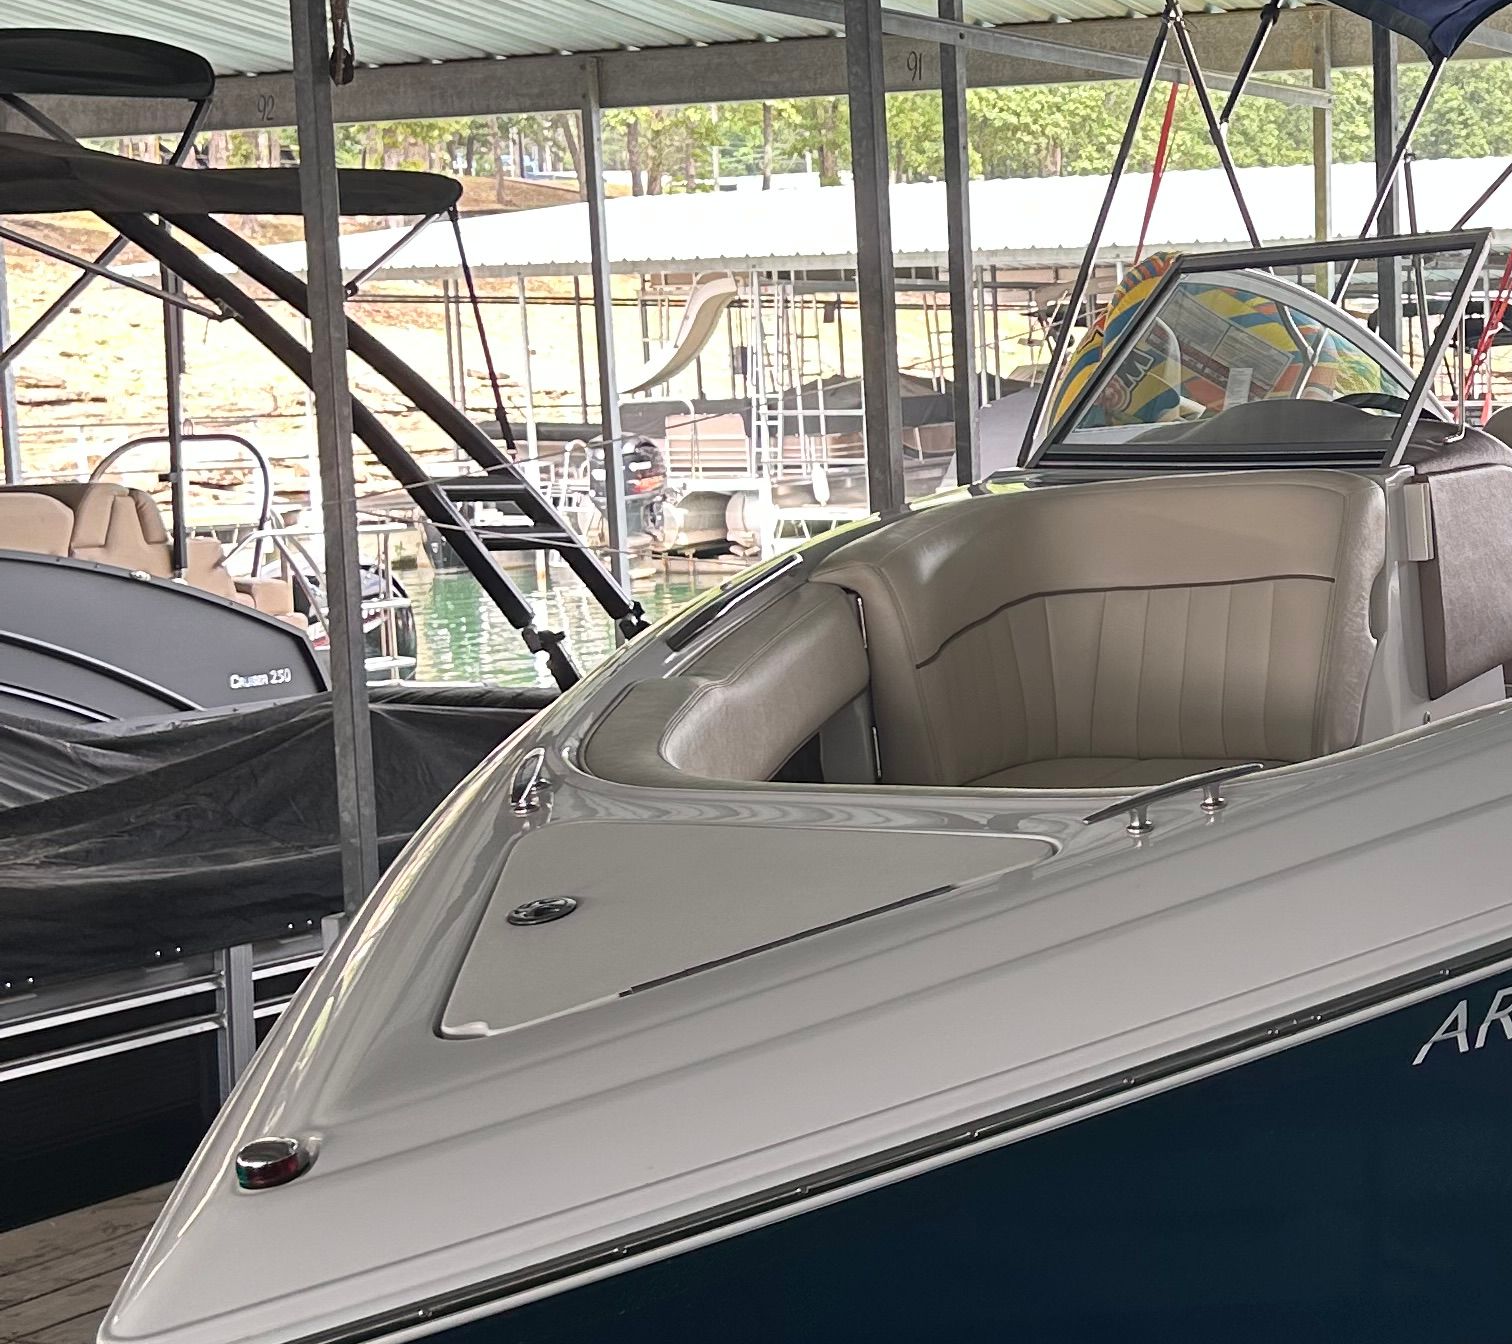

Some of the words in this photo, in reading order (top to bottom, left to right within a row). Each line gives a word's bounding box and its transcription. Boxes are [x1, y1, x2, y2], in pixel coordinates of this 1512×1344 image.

[907, 51, 922, 81] 91
[258, 95, 275, 121] 92
[269, 668, 292, 685] 250
